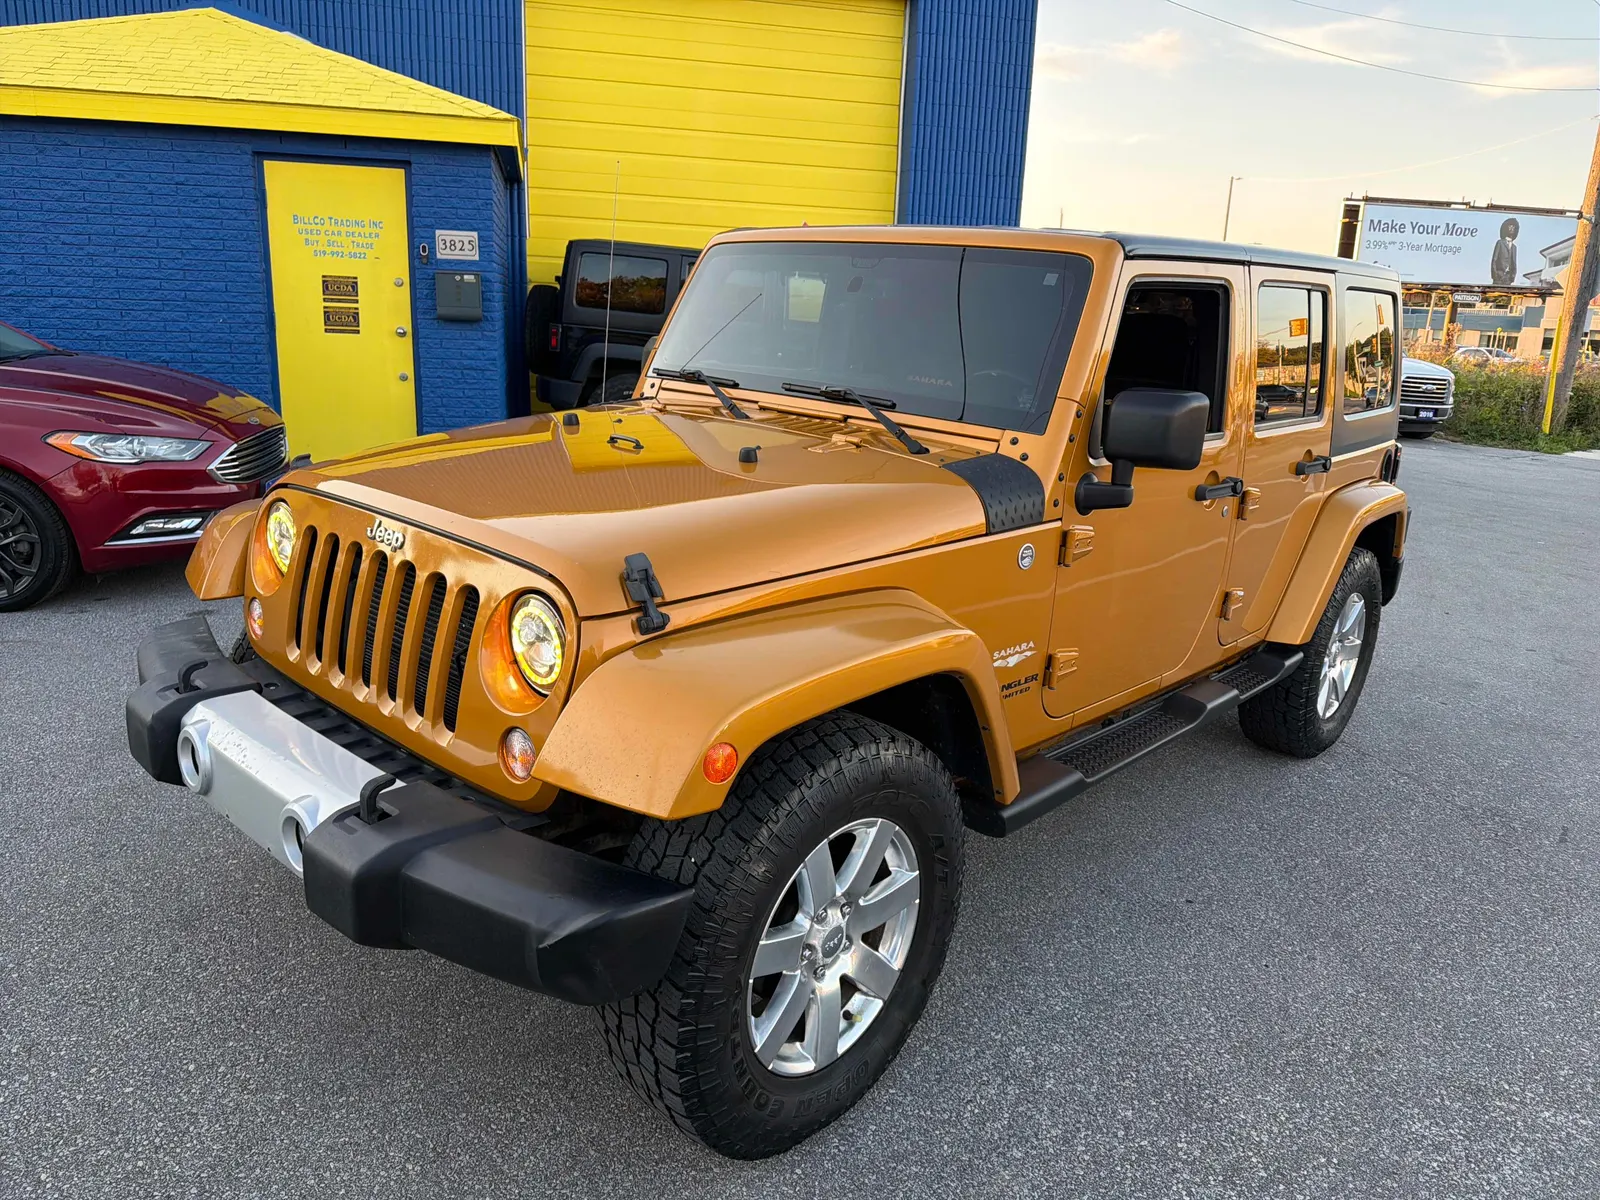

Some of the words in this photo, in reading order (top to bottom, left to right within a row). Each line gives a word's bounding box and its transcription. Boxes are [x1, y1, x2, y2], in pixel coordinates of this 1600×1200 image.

[297, 228, 322, 236] USED
[324, 229, 342, 237] CAR
[345, 231, 380, 239] DEALER
[1368, 219, 1407, 234] Make
[1410, 221, 1441, 236] Your
[1441, 222, 1478, 238] Move
[440, 238, 475, 252] 3825
[1398, 241, 1424, 252] 3-Year
[1424, 242, 1462, 255] Mortgage
[313, 249, 367, 260] 519-992-5822
[327, 284, 353, 292] UCDA
[329, 314, 354, 323] UCDA
[366, 518, 405, 552] Jeep
[993, 641, 1034, 660] SAHARA
[1001, 673, 1039, 693] NGLER
[1002, 686, 1030, 700] MITED
